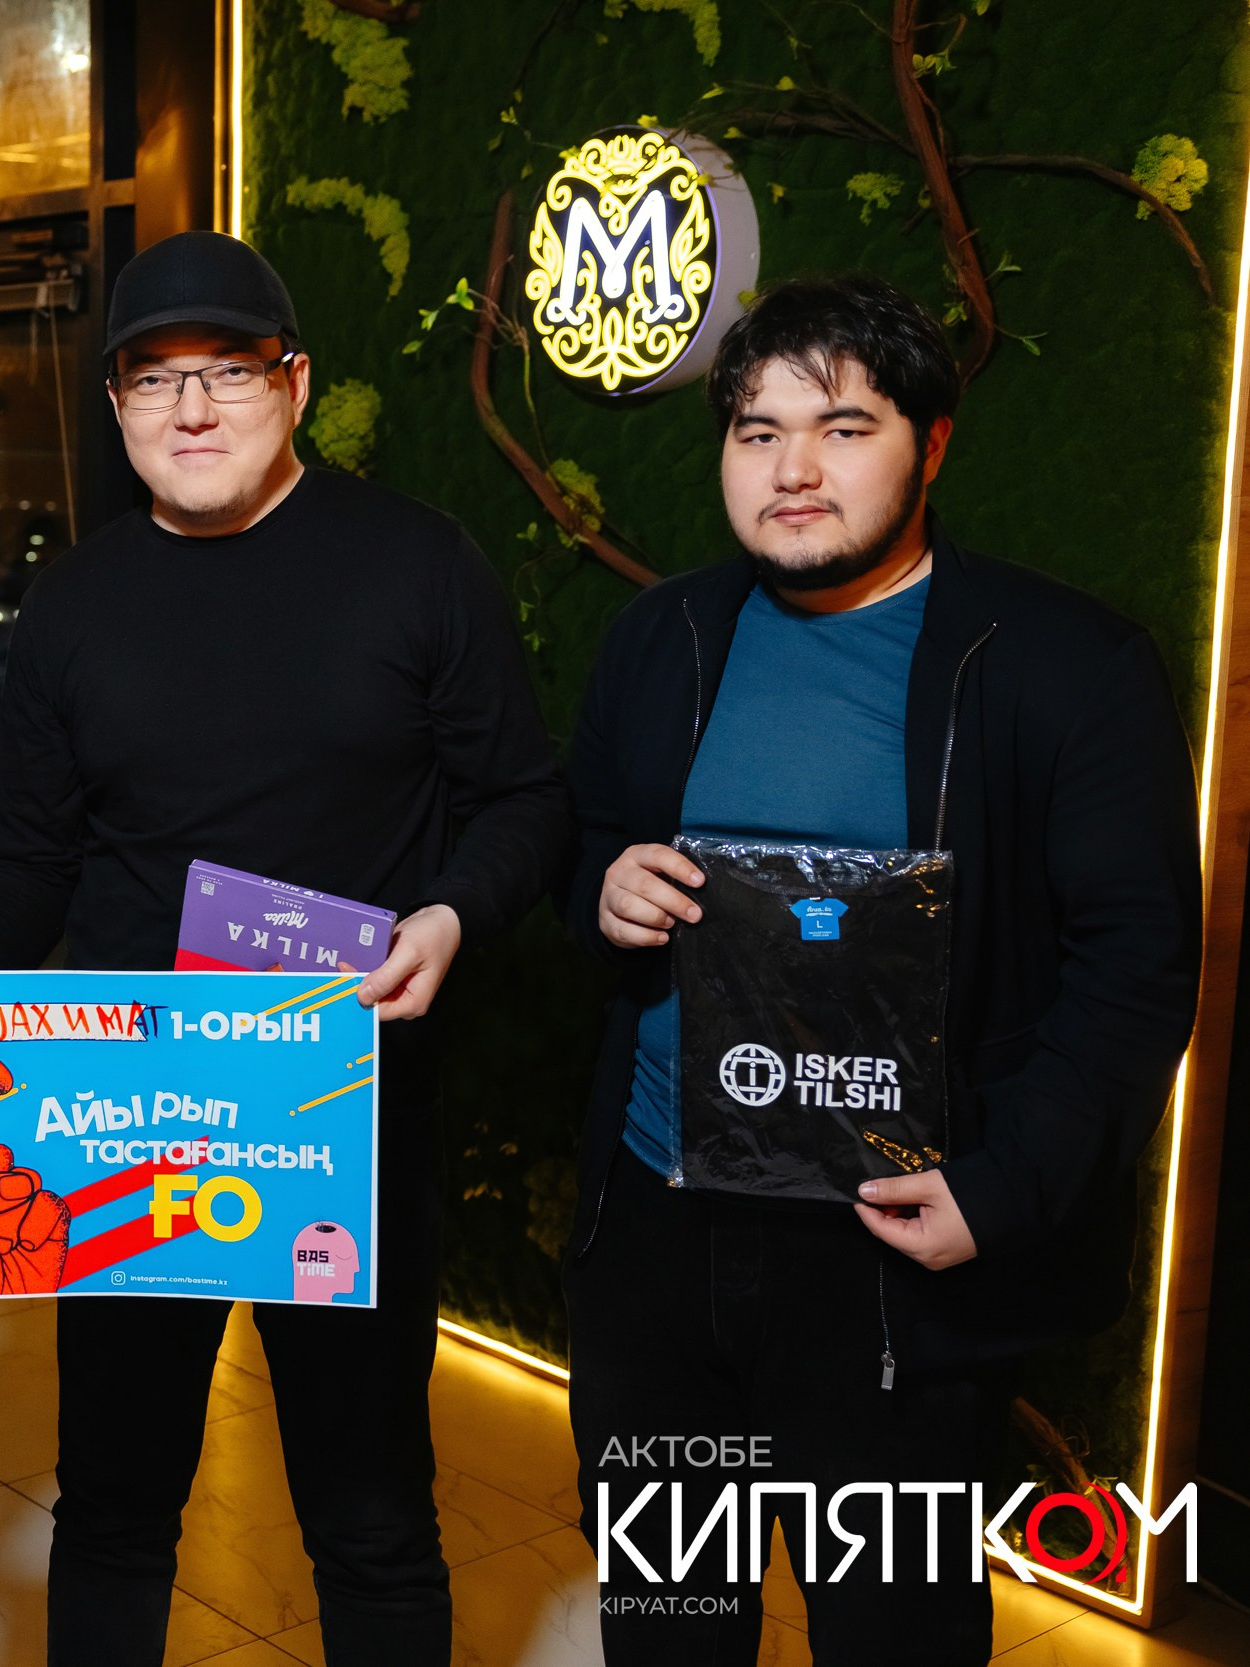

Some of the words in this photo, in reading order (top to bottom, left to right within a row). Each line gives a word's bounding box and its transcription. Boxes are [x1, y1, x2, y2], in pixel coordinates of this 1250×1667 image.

[262, 879, 300, 892] MILKA
[262, 910, 309, 929] Milka
[227, 921, 340, 968] MILKA
[170, 1010, 320, 1042] 1-ОРЫН
[795, 1053, 899, 1085] ISKER
[793, 1080, 902, 1112] TILSHI
[79, 1139, 334, 1176] тастағансың
[296, 1250, 329, 1263] BAS
